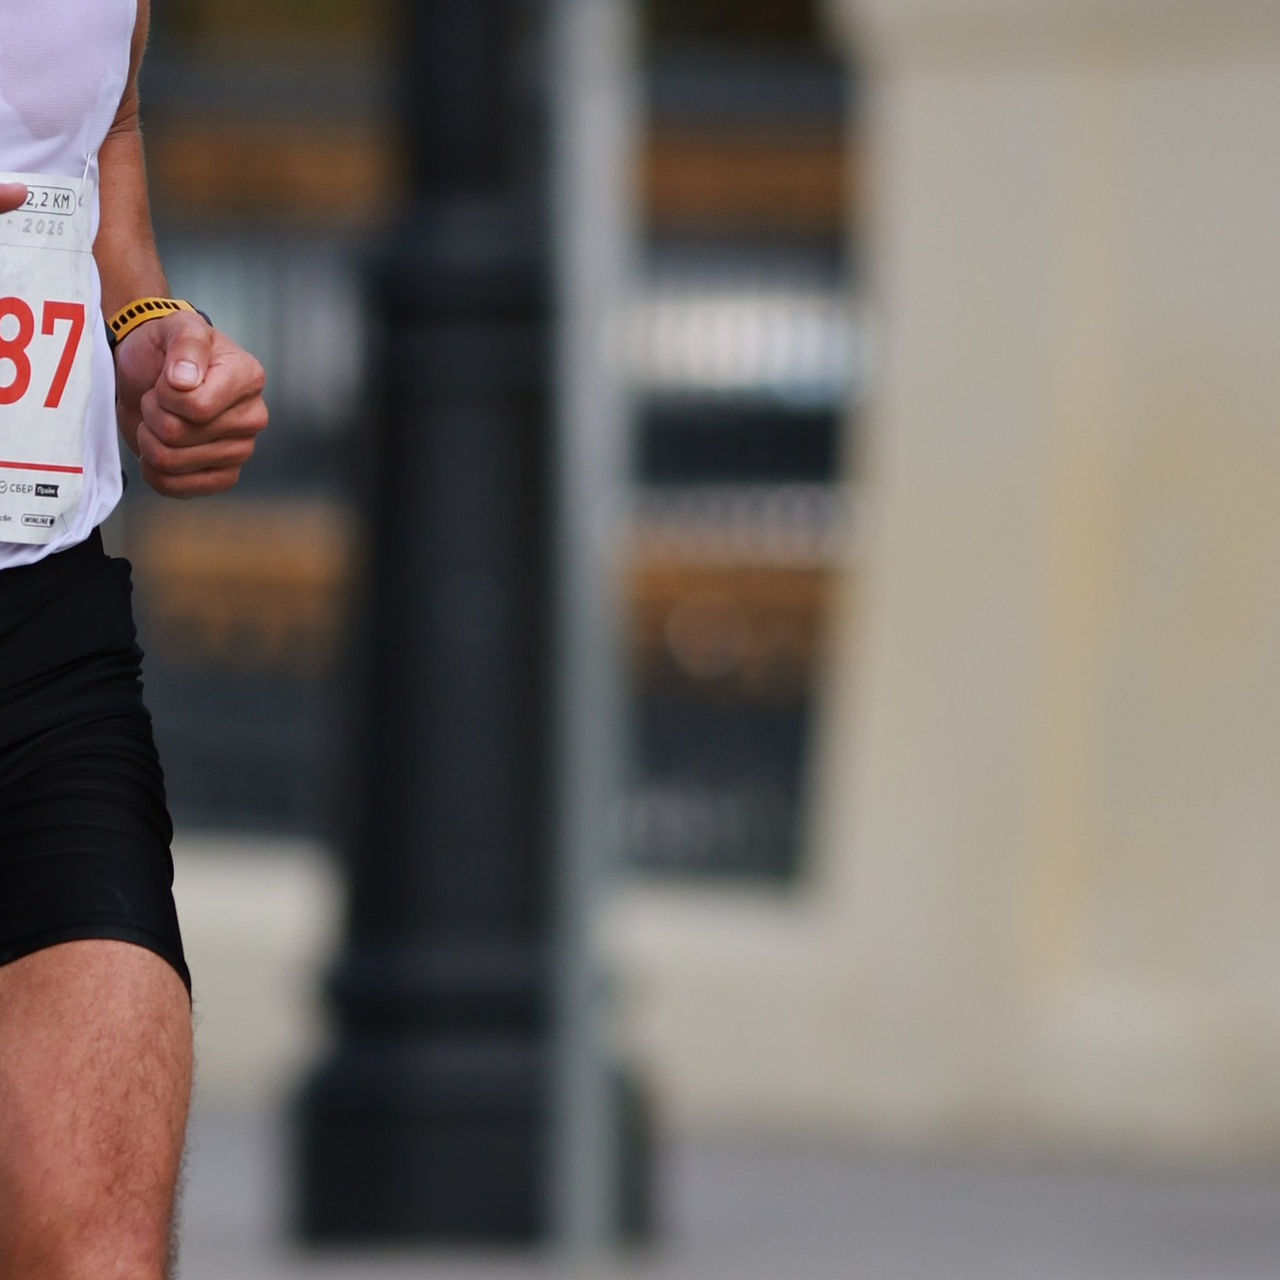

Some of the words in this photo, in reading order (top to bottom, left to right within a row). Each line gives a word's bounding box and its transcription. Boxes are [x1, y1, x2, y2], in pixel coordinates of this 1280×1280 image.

[24, 191, 49, 208] 2,2
[9, 483, 33, 494] СБЕР
[24, 516, 49, 526] WINLINE
